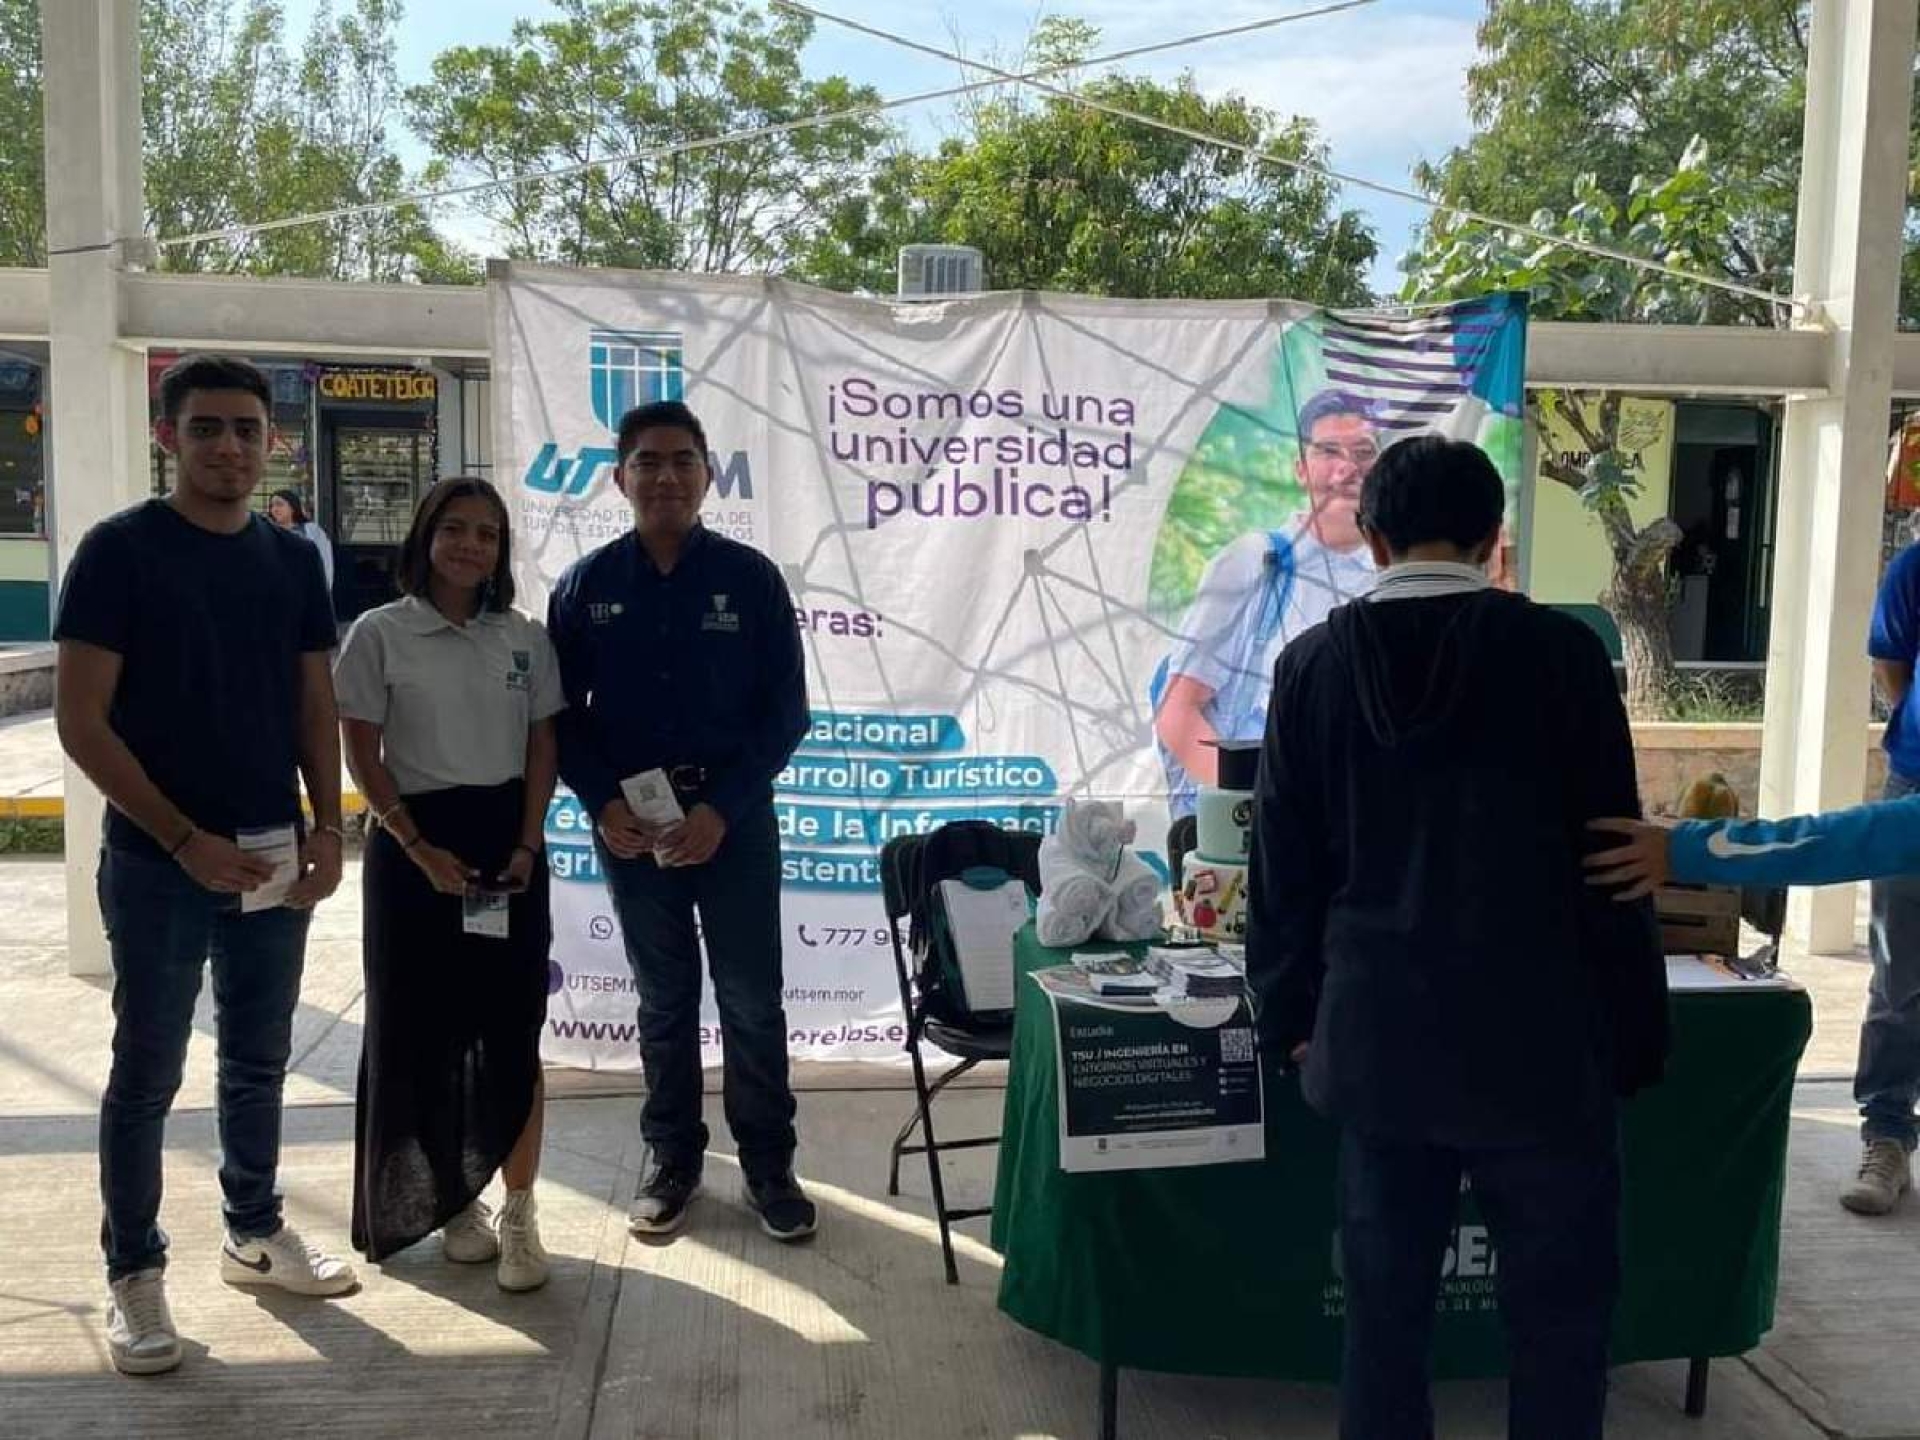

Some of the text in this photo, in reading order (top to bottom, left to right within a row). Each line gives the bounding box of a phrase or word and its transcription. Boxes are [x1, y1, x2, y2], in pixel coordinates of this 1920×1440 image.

[829, 378, 1135, 426] ¡Somos una
[831, 426, 1132, 470] universidad
[867, 467, 1110, 529] pública!
[795, 608, 882, 637] eras:
[898, 761, 1043, 790] Turístico
[833, 811, 863, 838] la
[821, 927, 866, 946] 777
[567, 974, 626, 993] UTSEM
